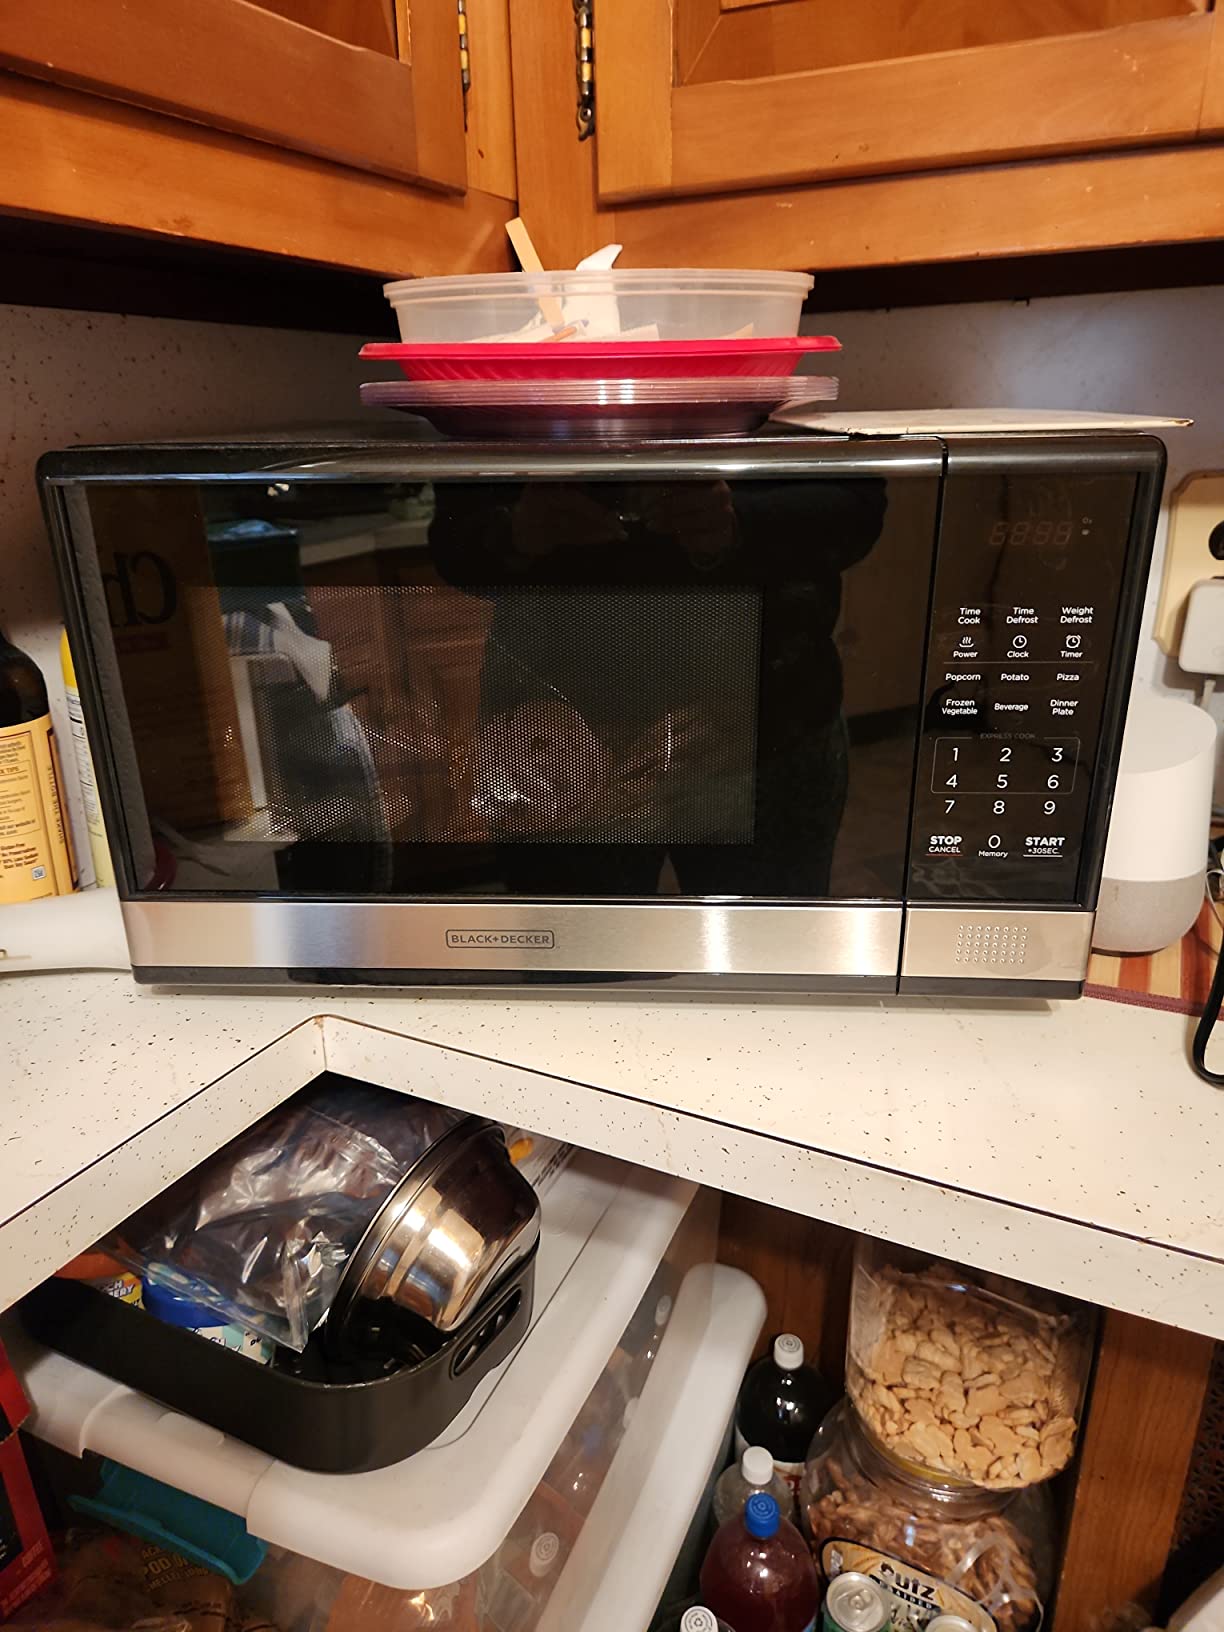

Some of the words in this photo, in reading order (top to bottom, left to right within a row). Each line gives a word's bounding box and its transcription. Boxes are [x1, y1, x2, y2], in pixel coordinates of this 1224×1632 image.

[959, 607, 981, 616] Time
[1013, 606, 1035, 615] Time
[1061, 606, 1094, 616] Weight
[957, 616, 981, 625] Cook
[1006, 615, 1039, 624] Defrost
[1059, 615, 1093, 624] Defrost
[952, 650, 978, 658] Power
[1006, 650, 1030, 658] Clock
[1060, 650, 1083, 658] Timer
[945, 672, 981, 681] Popcorn
[1000, 673, 1030, 681] Potato
[1056, 672, 1080, 681] Pizza
[945, 698, 976, 707] Frozen
[994, 702, 1029, 712] Beverage
[1049, 699, 1079, 707] Dinner
[941, 707, 978, 716] Vegetable
[1051, 707, 1074, 716] Plate
[952, 747, 959, 762] 1
[999, 747, 1012, 762] 2
[1051, 747, 1064, 763] 3
[945, 774, 958, 788] 4
[996, 774, 1008, 789] 5
[1047, 774, 1059, 789] 6
[944, 799, 956, 814] 7
[992, 800, 1005, 815] 8
[1043, 800, 1056, 815] 9
[929, 835, 963, 846] STOP
[987, 834, 1001, 849] 0
[1025, 836, 1066, 847] START
[928, 845, 961, 853] CANCEL
[978, 850, 1009, 858] Memory
[451, 934, 550, 944] BLACK+DECKER
